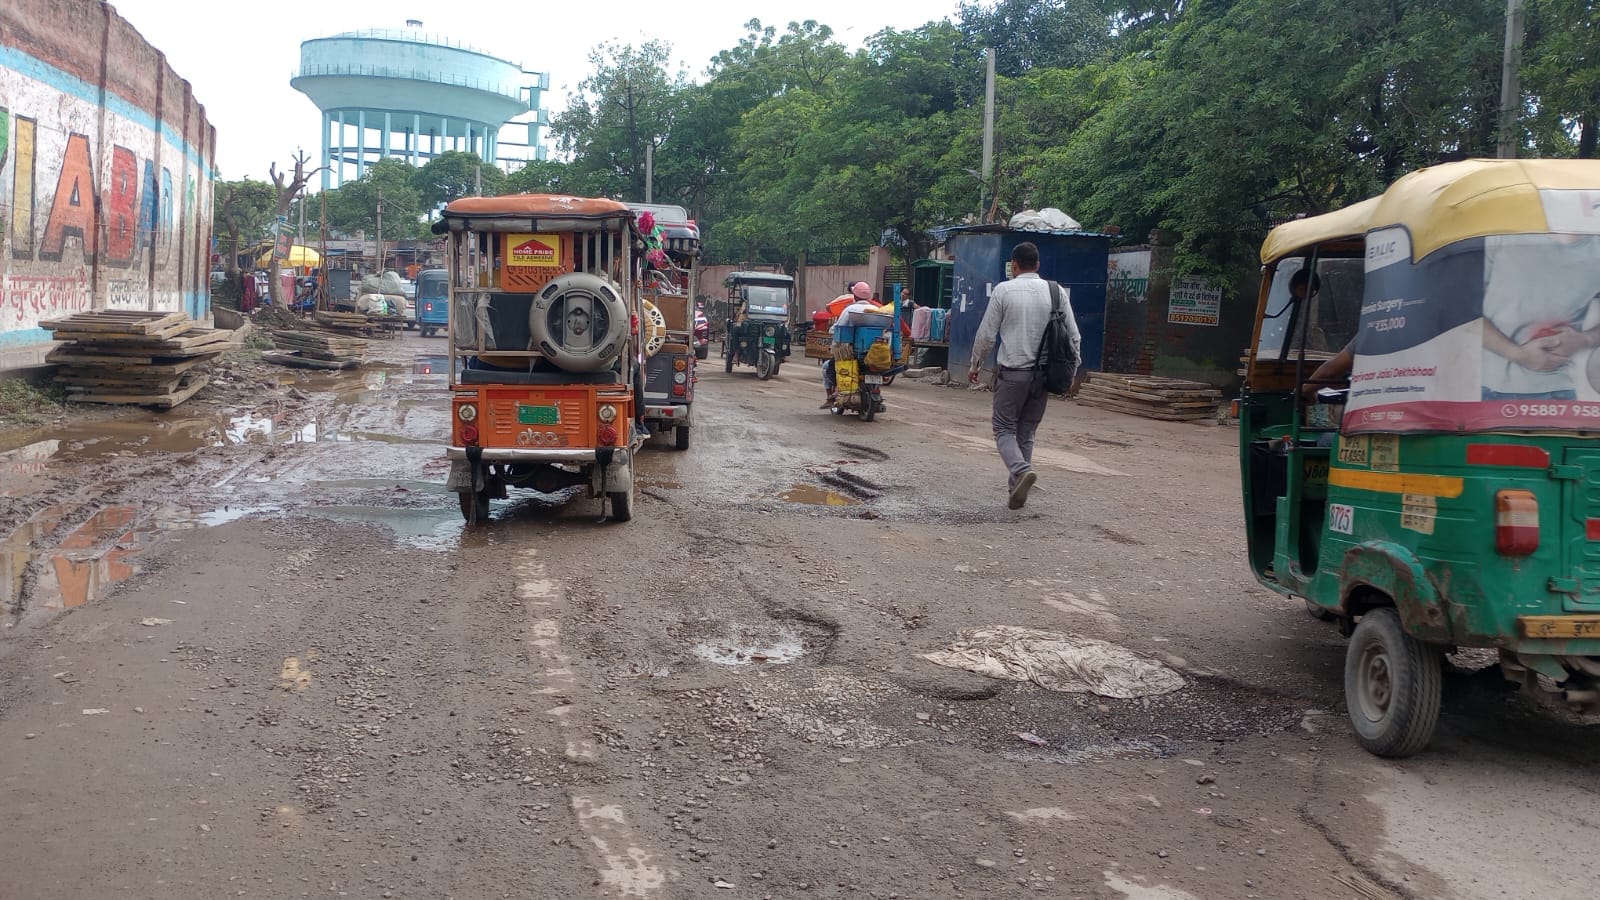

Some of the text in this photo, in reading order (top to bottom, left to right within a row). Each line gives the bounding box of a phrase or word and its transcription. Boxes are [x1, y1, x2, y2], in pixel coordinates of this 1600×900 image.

[0, 106, 174, 271] IABAD
[1376, 298, 1404, 313] Surgery
[1520, 404, 1567, 416] 95887
